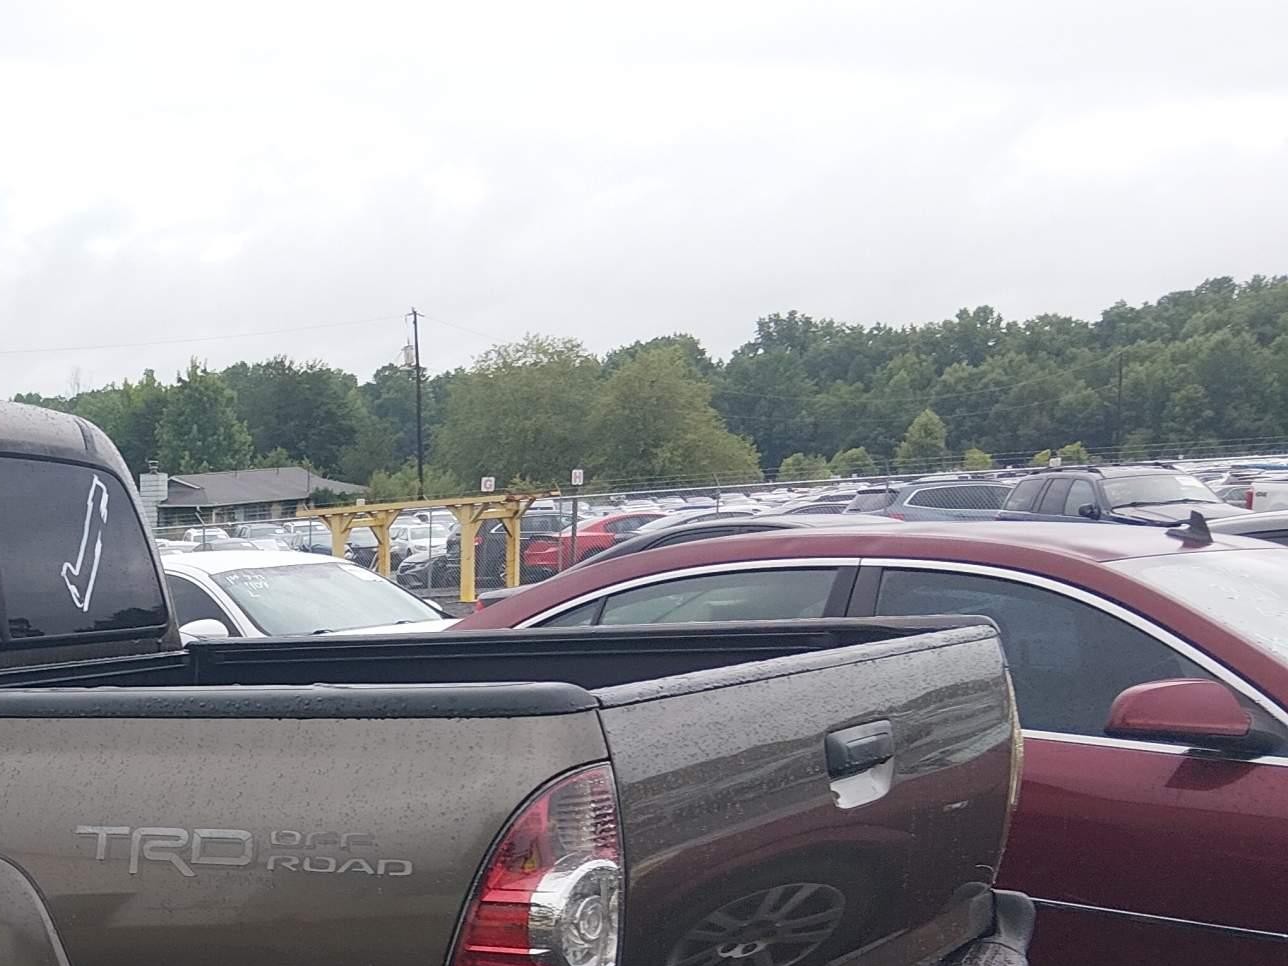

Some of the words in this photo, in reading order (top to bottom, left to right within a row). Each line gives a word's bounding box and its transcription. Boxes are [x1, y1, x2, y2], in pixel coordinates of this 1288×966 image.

[483, 479, 493, 490] G
[574, 471, 582, 483] H
[75, 825, 254, 877] TRD
[270, 830, 377, 852] OFF
[266, 855, 413, 876] ROAD
